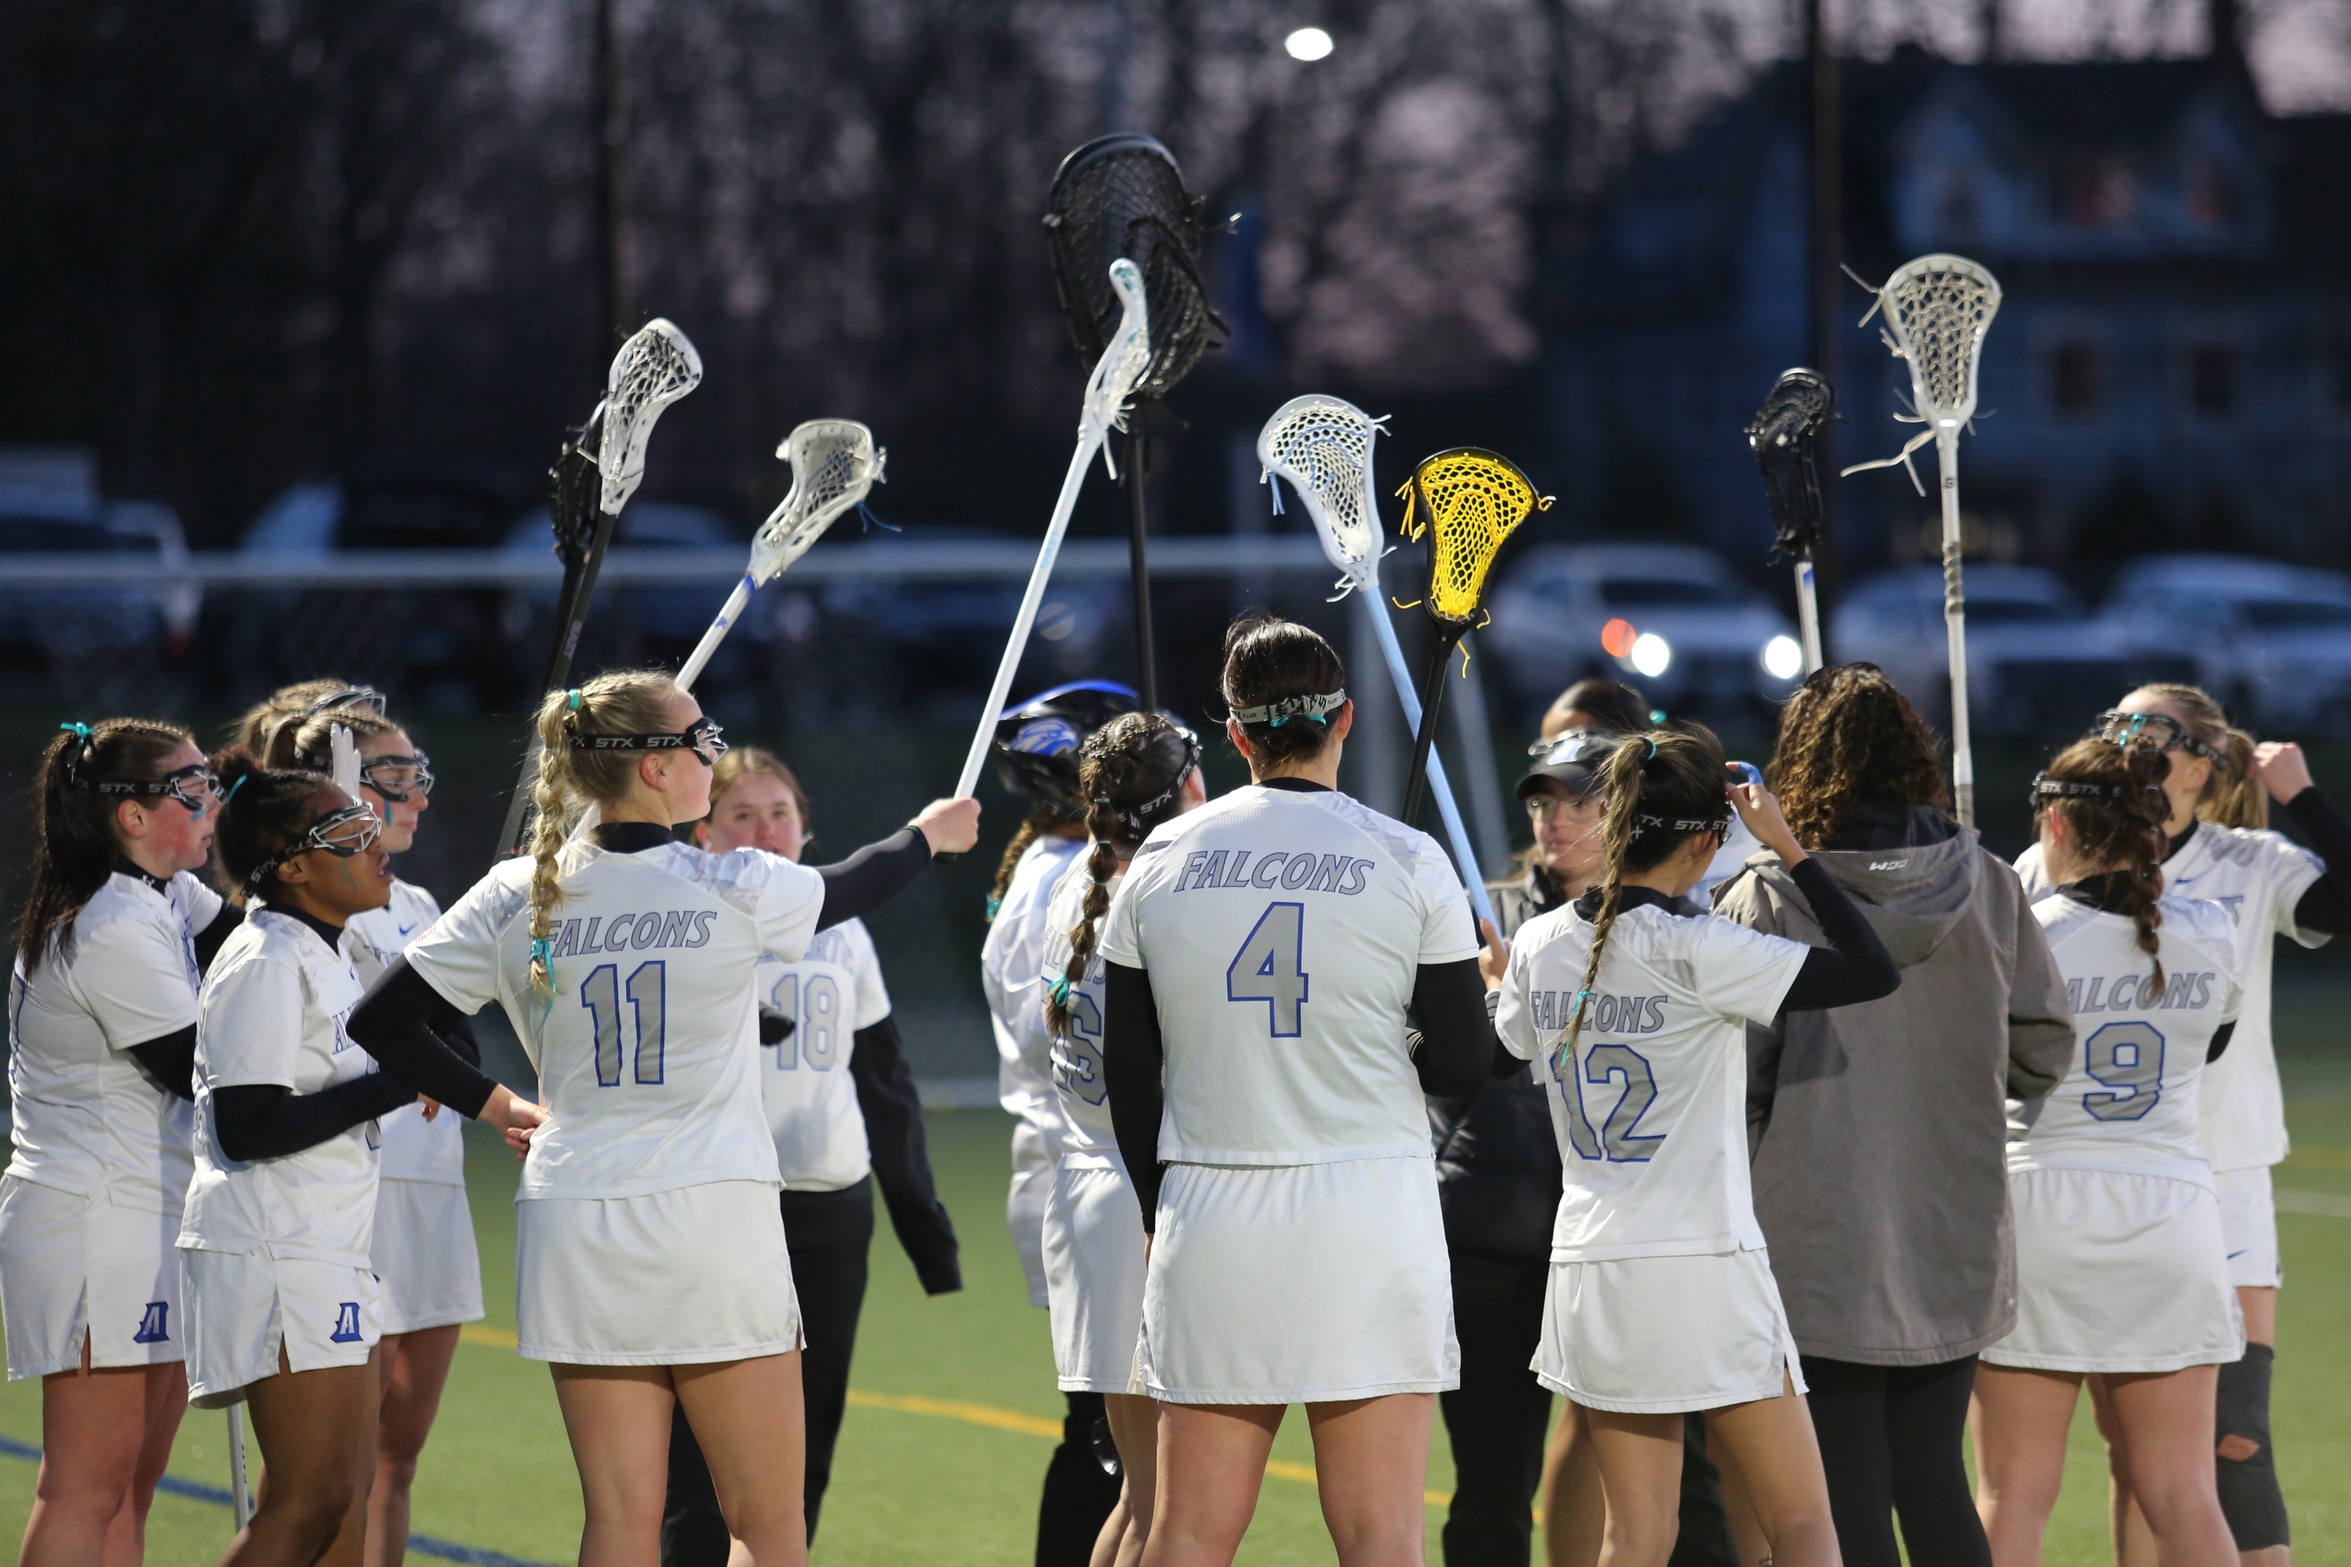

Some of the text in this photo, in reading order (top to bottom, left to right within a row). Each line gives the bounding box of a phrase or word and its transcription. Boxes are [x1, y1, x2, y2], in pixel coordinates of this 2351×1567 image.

[595, 737, 634, 748] STX
[646, 736, 684, 748] STX
[100, 783, 135, 794] STX
[148, 783, 173, 794] ST
[1140, 789, 1173, 814] STX
[2040, 781, 2062, 794] STX
[2068, 783, 2101, 796] STX
[1640, 814, 1729, 831] TX STX ST
[1173, 850, 1375, 896] FALCONS
[1226, 901, 1309, 1038] 4
[2066, 972, 2216, 1015] ALCONS
[580, 960, 666, 1087] 11
[771, 973, 839, 1072] 18
[2082, 1021, 2166, 1122] 9
[1549, 1041, 1667, 1163] 12
